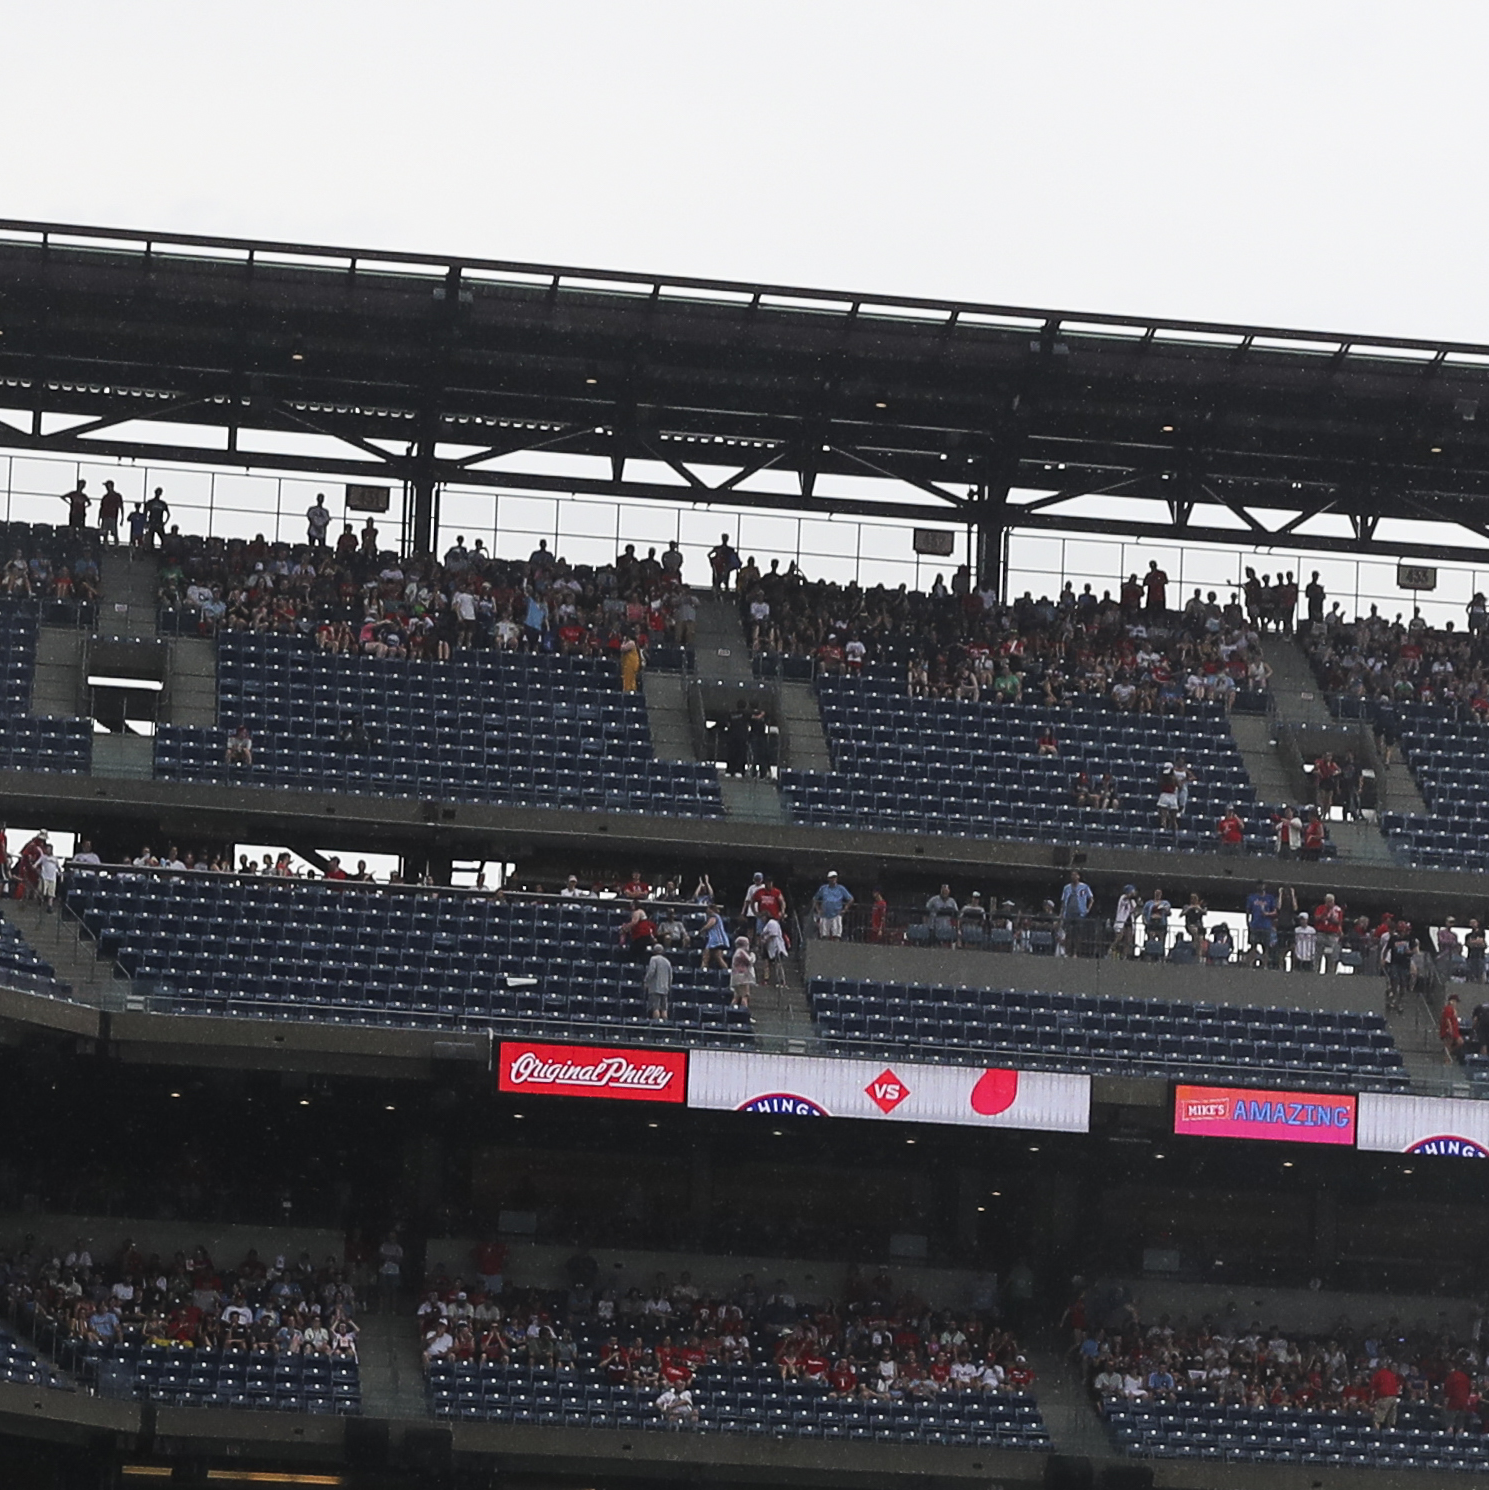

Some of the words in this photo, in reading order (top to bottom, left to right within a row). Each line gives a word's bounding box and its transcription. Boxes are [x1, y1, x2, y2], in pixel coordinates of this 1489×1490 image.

[874, 1084, 900, 1100] VS
[1188, 1103, 1226, 1117] MIKE'S
[1233, 1100, 1351, 1128] AMAZING
